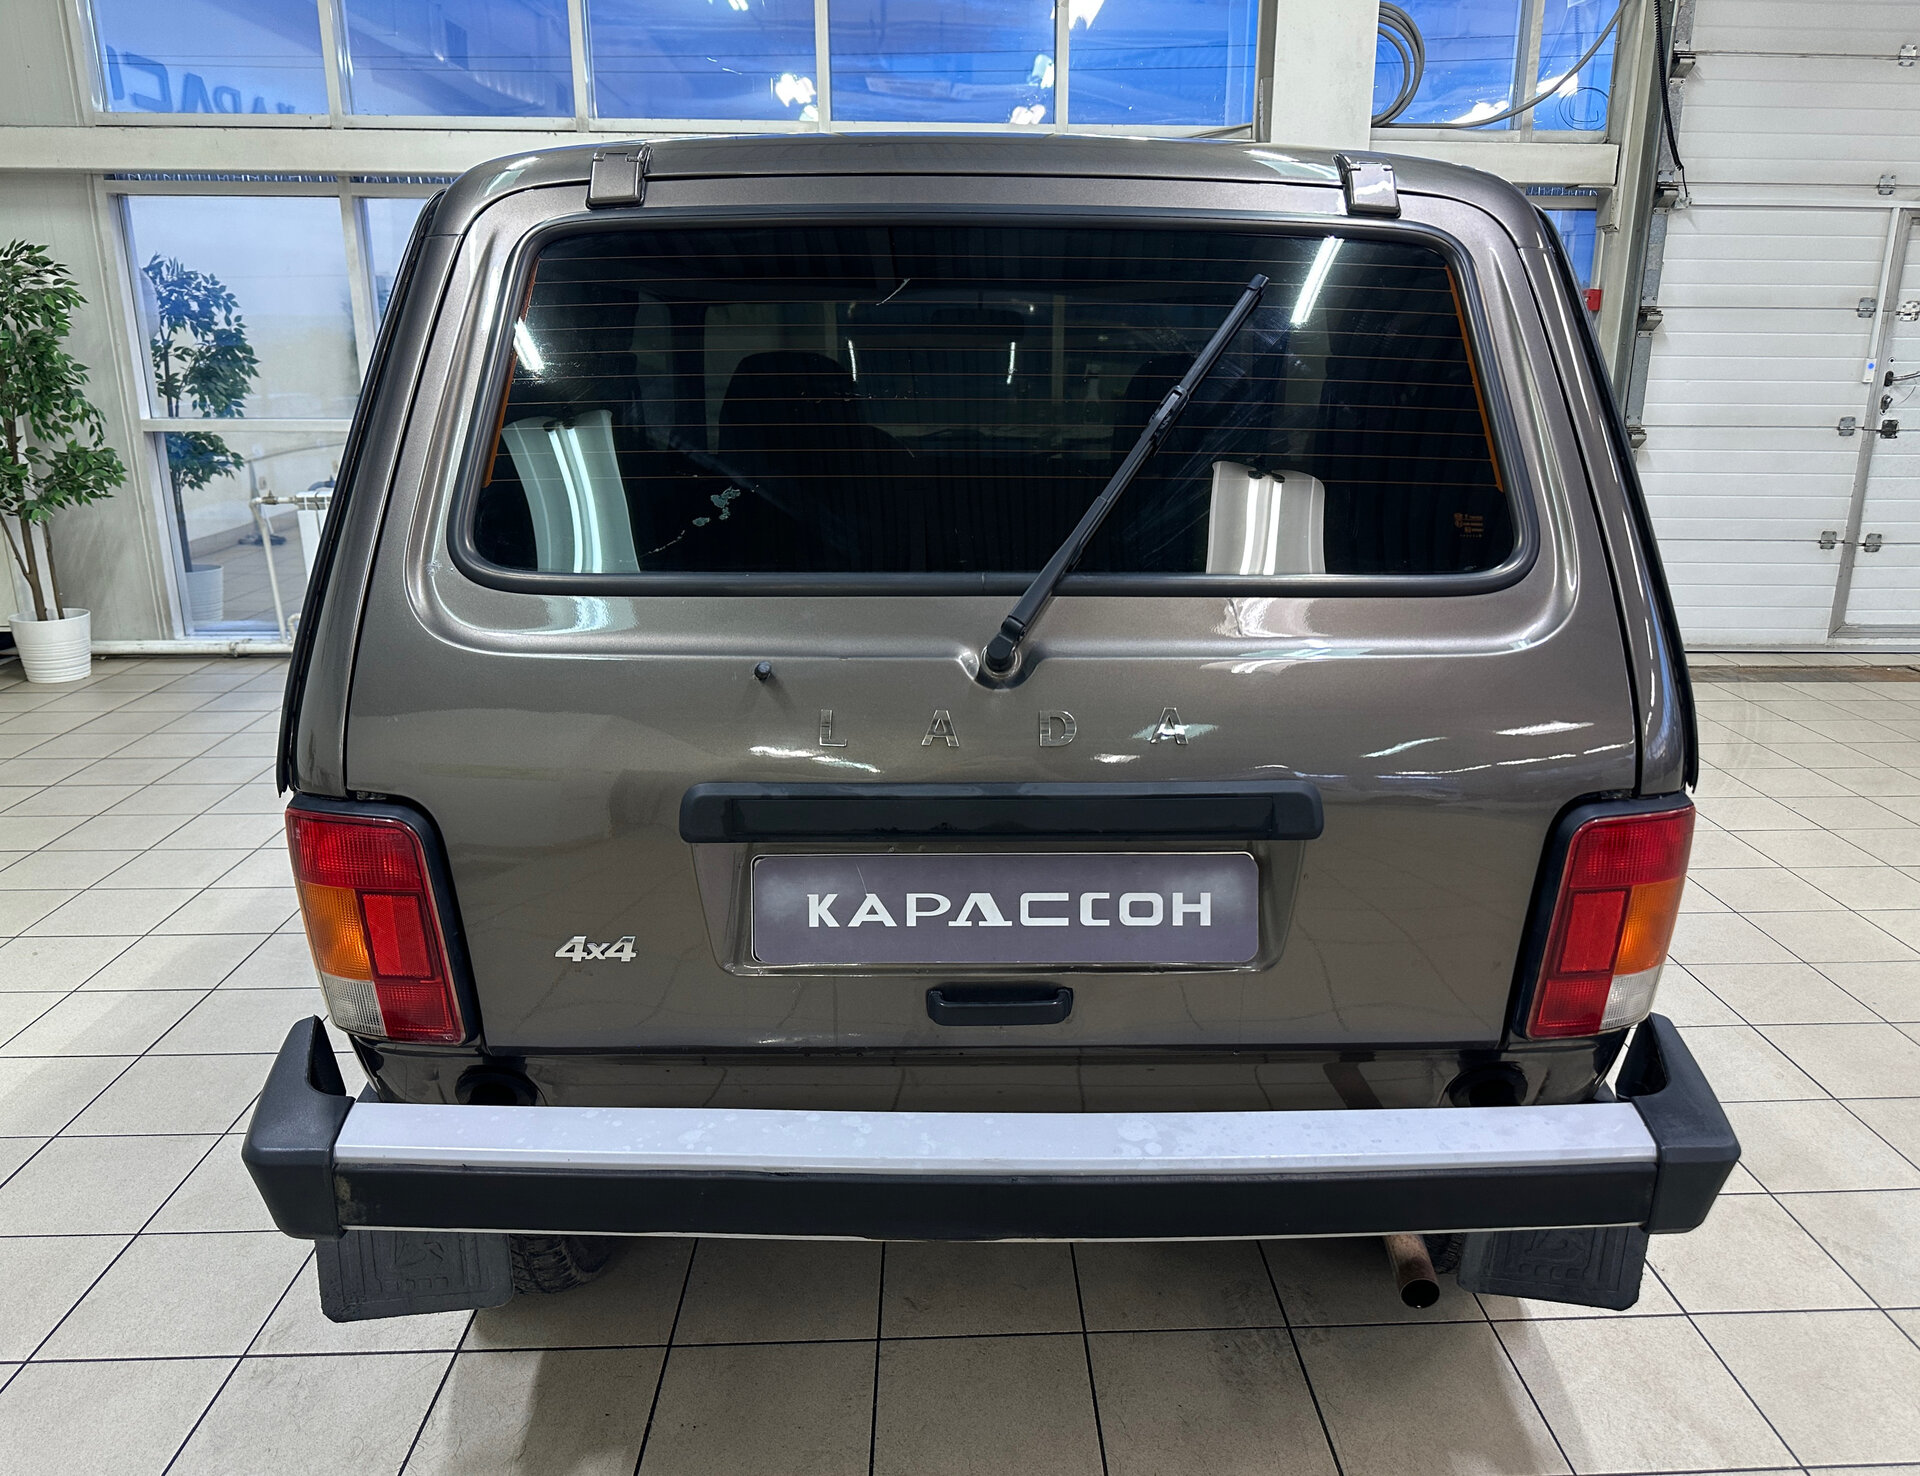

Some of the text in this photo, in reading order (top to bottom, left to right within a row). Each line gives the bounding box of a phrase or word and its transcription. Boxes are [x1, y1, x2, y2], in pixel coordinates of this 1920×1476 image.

[817, 706, 1189, 748] LADA
[807, 892, 1212, 928] КАРАССОН
[554, 935, 637, 962] 4x4
